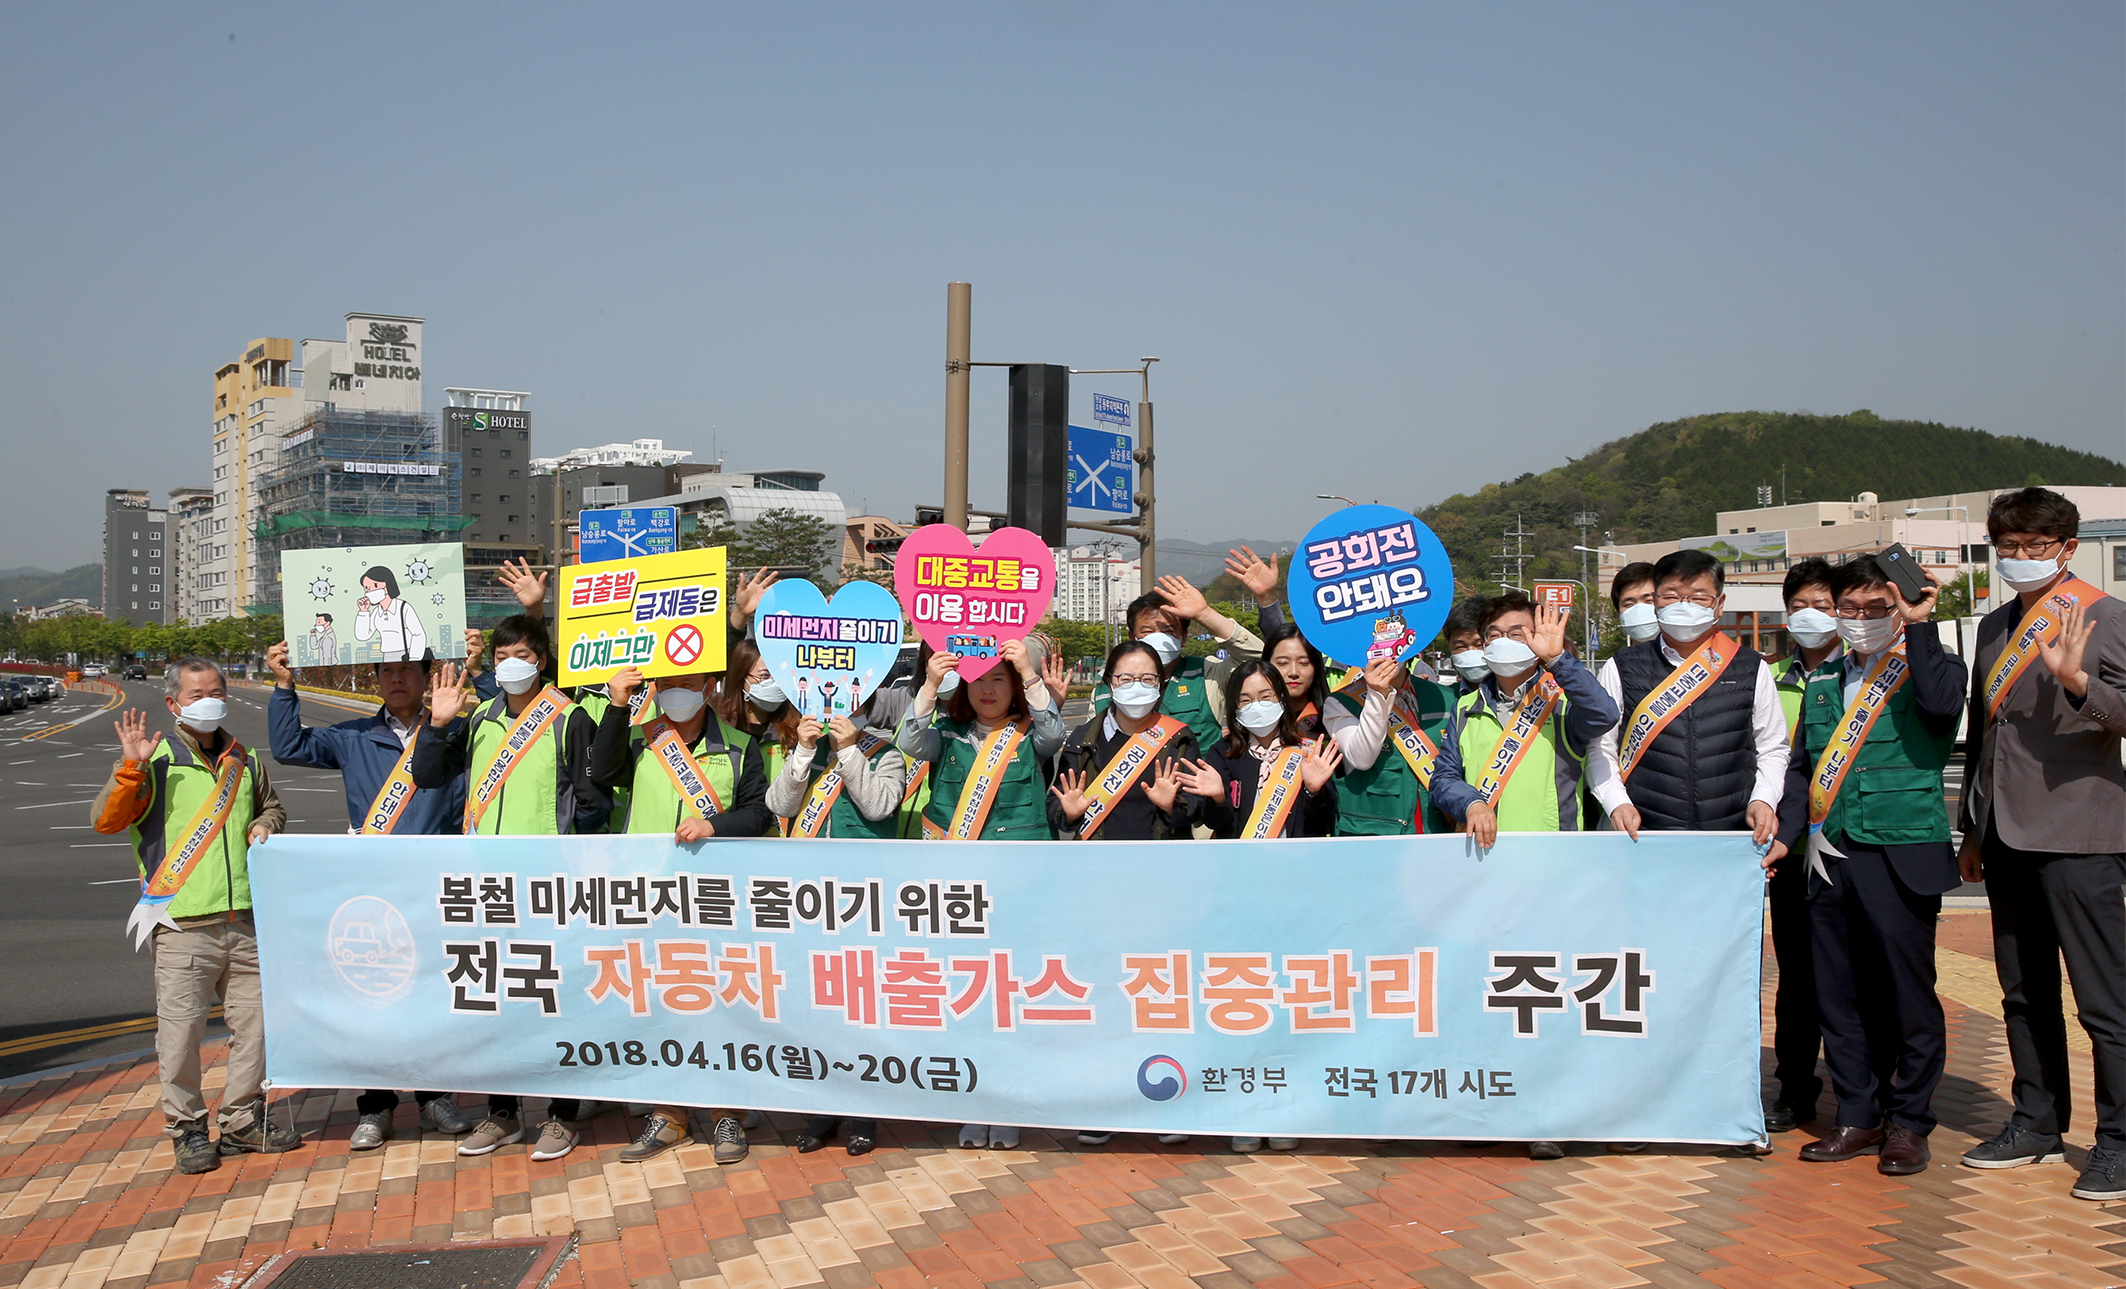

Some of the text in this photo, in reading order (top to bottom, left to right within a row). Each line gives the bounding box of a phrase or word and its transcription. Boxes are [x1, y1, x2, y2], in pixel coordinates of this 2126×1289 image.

[354, 362, 421, 381] 베네치아
[491, 416, 528, 429] HOTEL
[617, 519, 637, 528] 팔마로
[1308, 523, 1417, 578] 공회전
[571, 571, 636, 606] 급출발
[916, 556, 1040, 591] 대중교통을
[635, 587, 718, 622] 급제동은
[915, 592, 1026, 625] 이용 합시다
[1316, 567, 1428, 622] 안돼요
[1546, 588, 1568, 602] E1
[569, 633, 655, 670] 이제그만
[796, 645, 855, 671] 나부터
[1648, 662, 1710, 719] 대중교통을
[507, 699, 557, 752] 대중교통을
[1510, 694, 1549, 740] 미세먼지
[1817, 656, 1909, 793] 미세먼지 줄이기 나부터
[1395, 724, 1431, 761] 줄이기
[1490, 737, 1522, 776] 줄이기
[475, 749, 516, 804] 이용합시다
[660, 739, 707, 798] 대중교통을
[1101, 744, 1148, 796] 공회전
[1281, 752, 1303, 785] 급출발,
[370, 781, 410, 832] 안돼요
[799, 797, 826, 835] 나부터
[440, 875, 991, 936] 봄철 미세먼지를 줄이기 위한
[444, 941, 1653, 1036] 전국 자동차 배출가스 집중관리 주간
[555, 1038, 979, 1093] 2018.04.16(월)~20(금)
[1201, 1066, 1288, 1094] 환경부
[1324, 1066, 1517, 1100] 전국 17개 시도
